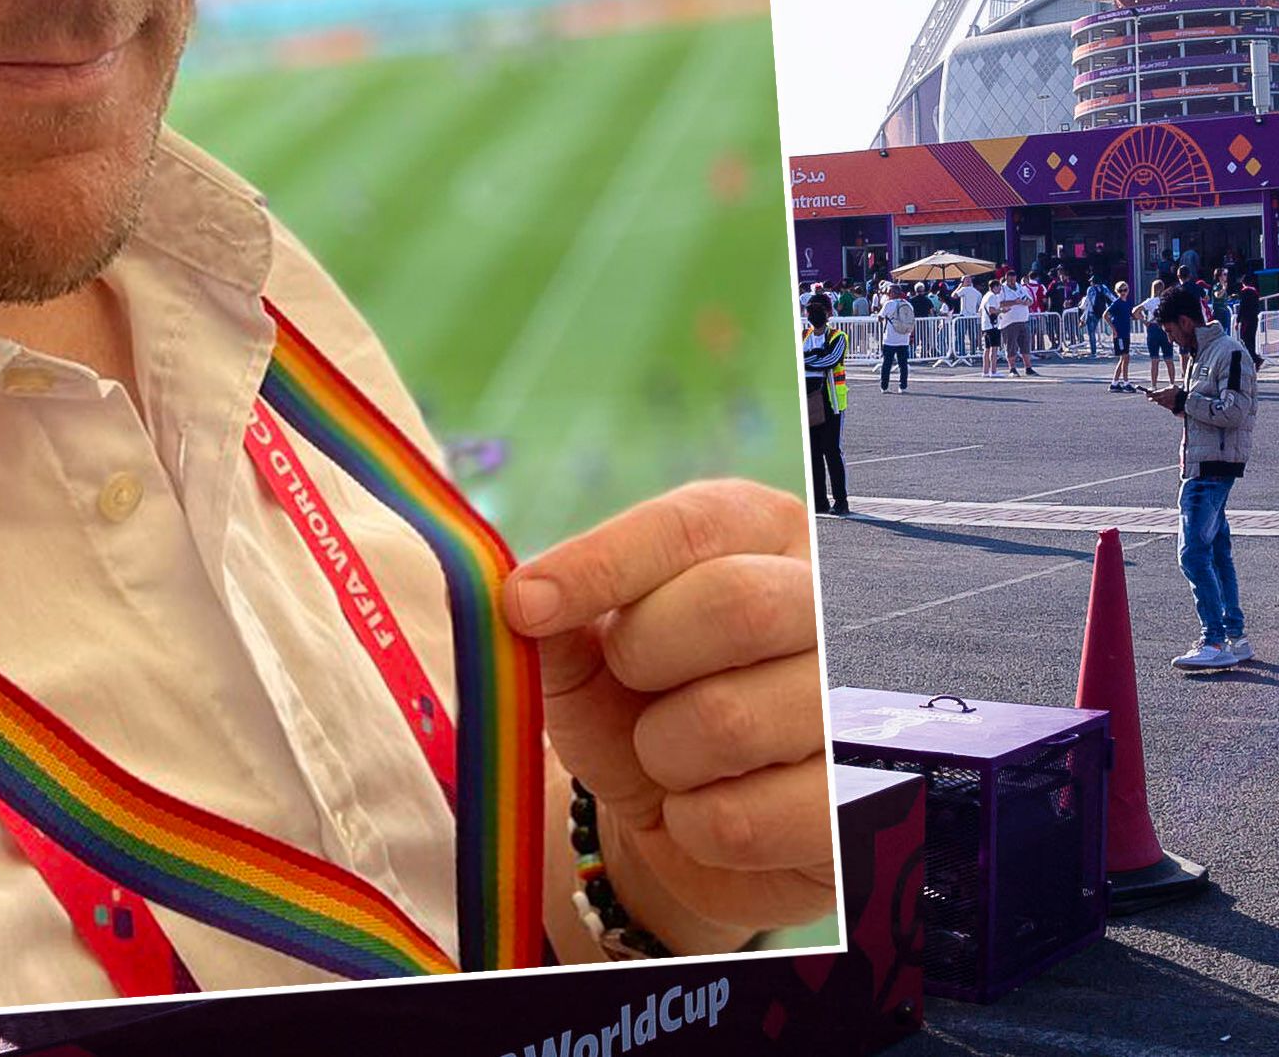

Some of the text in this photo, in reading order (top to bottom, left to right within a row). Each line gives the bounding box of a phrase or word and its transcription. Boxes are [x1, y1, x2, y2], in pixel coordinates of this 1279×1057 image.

[1023, 167, 1030, 178] E
[791, 194, 846, 209] ntrance
[270, 449, 349, 573] WORLD
[345, 568, 395, 650] FIFA
